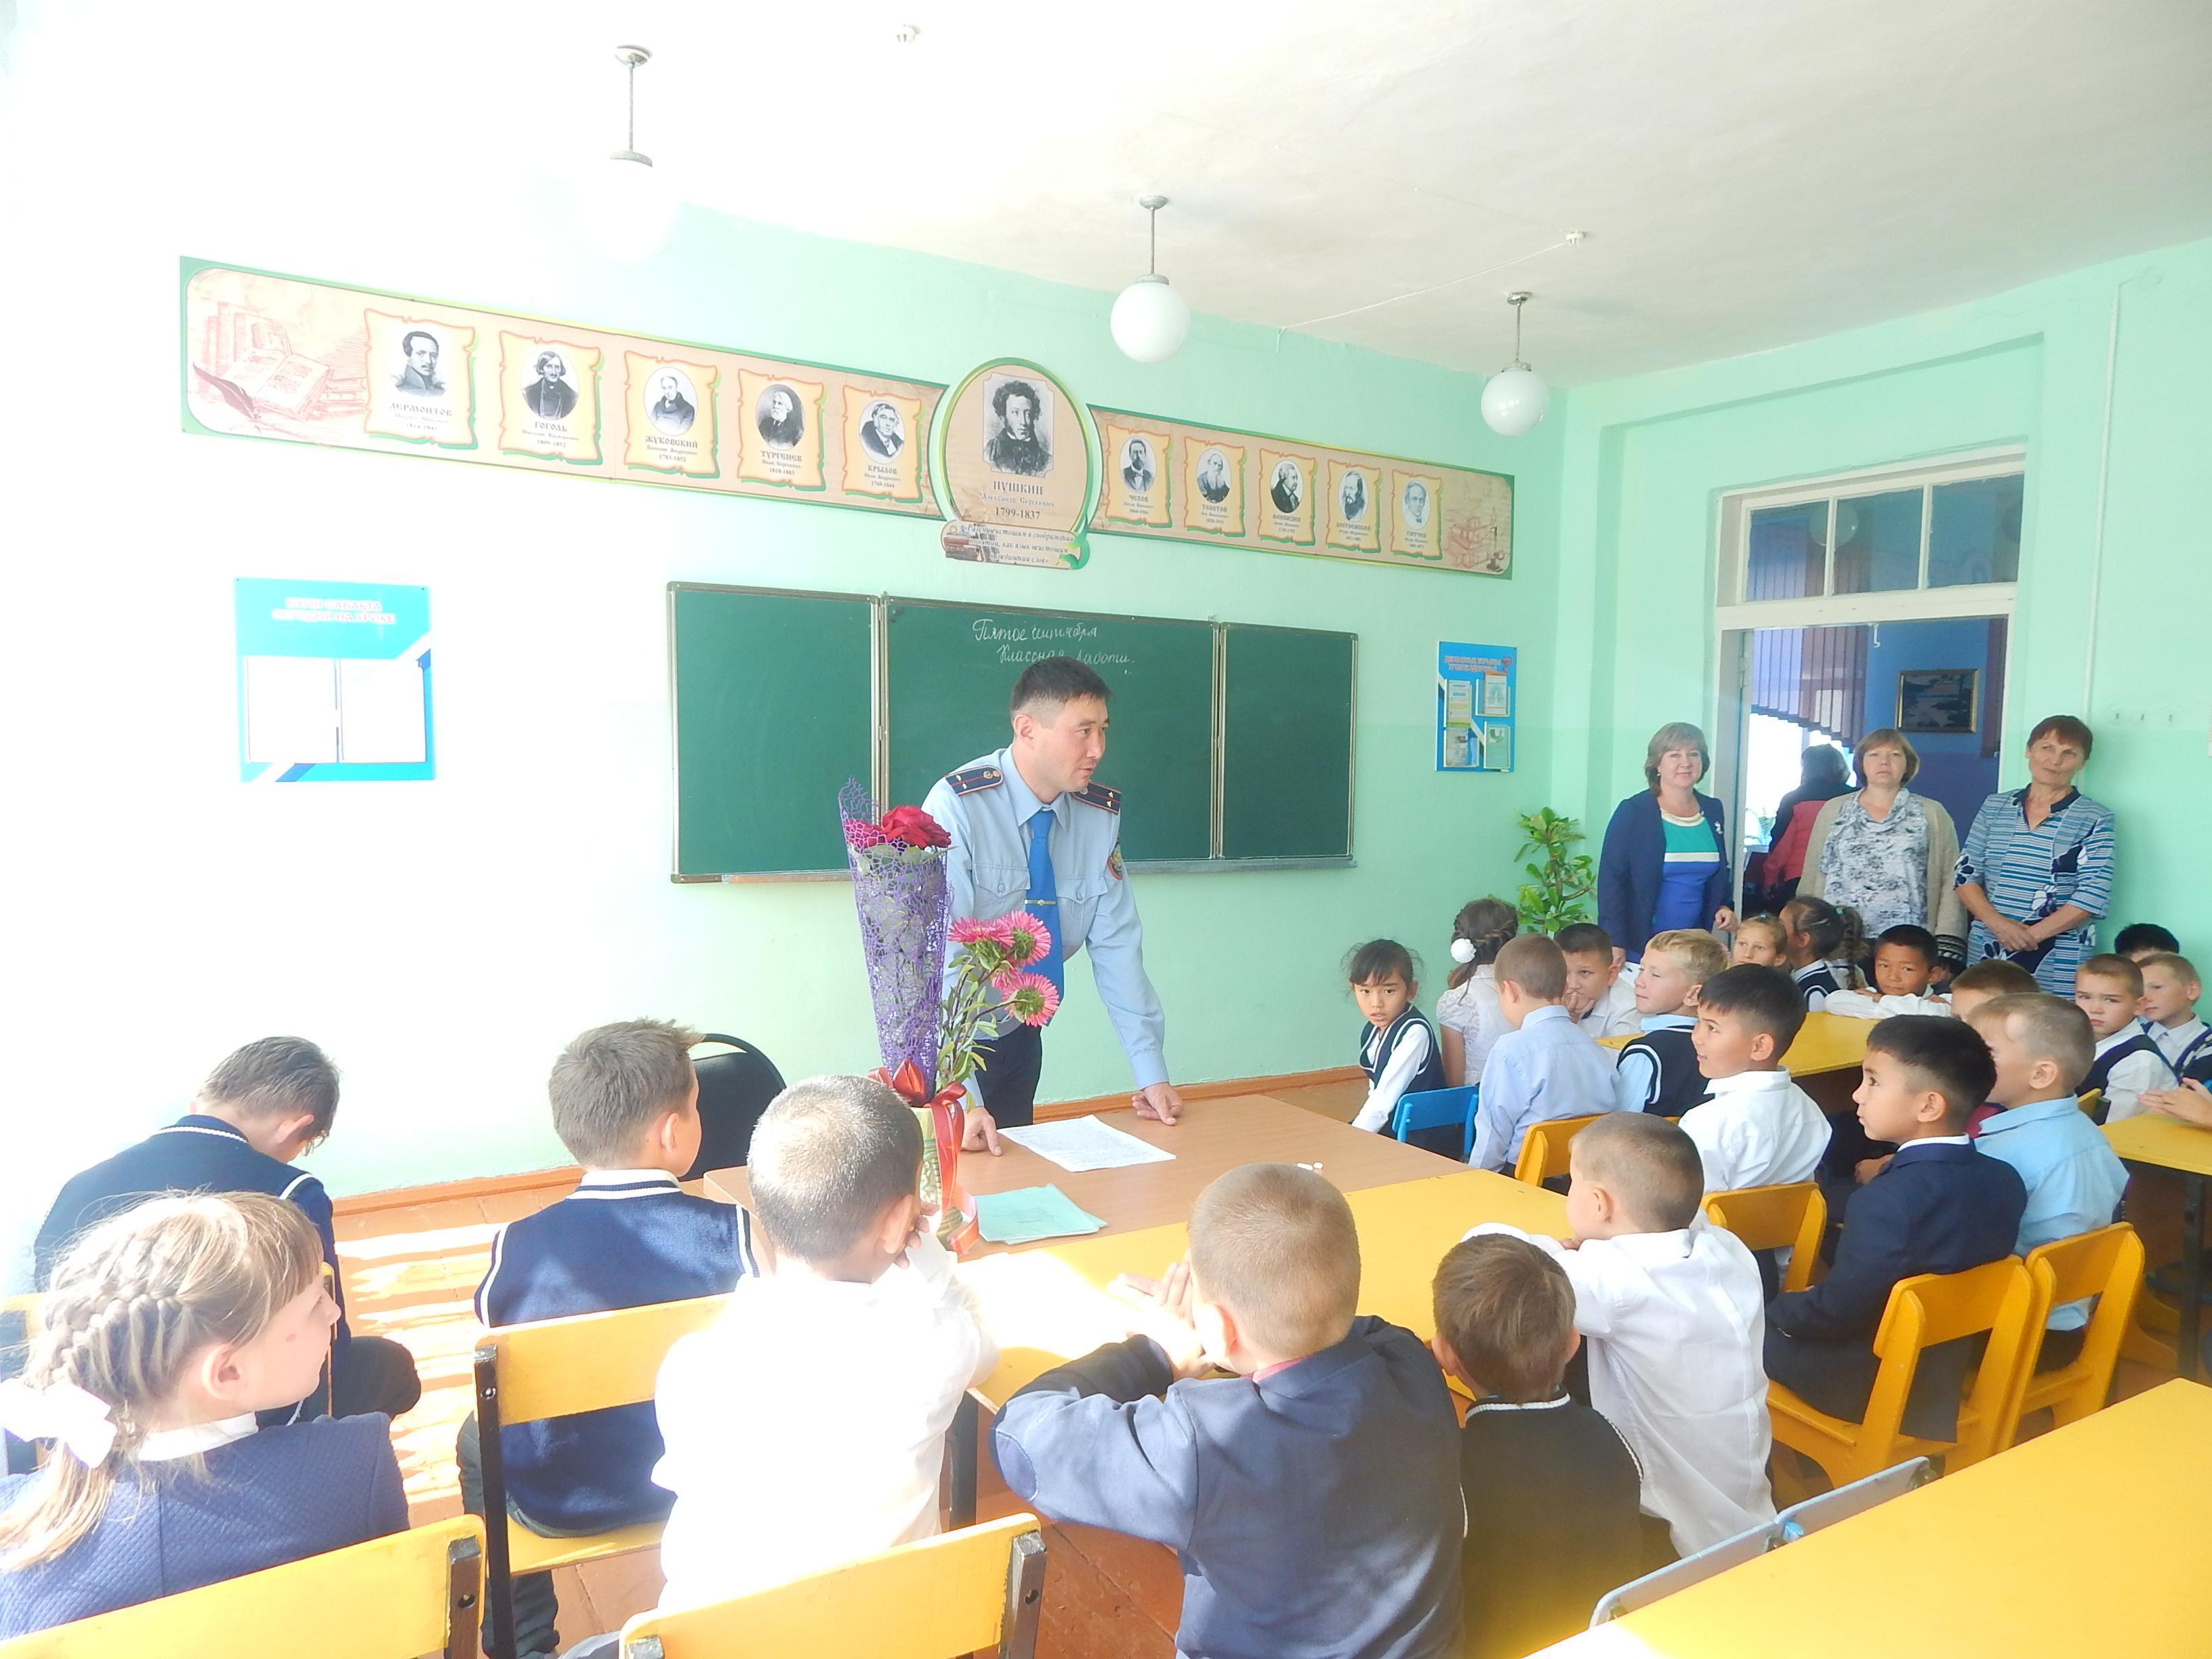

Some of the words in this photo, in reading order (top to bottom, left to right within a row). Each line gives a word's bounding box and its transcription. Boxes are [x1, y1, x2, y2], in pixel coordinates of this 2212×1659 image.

[535, 421, 567, 432] ГОГОЛЬ
[645, 435, 698, 449] ЖУКОВСКИЙ
[760, 450, 802, 462] ТУРГЕНЕВ
[867, 464, 898, 475] КРЫЛОВ
[994, 480, 1043, 495] ПУШКИН
[1128, 494, 1149, 503] ЧЕХОВ
[996, 506, 1041, 520] 1799-1837
[1202, 504, 1228, 513] ТОЛСТОЙ
[972, 618, 1028, 641] Пятое
